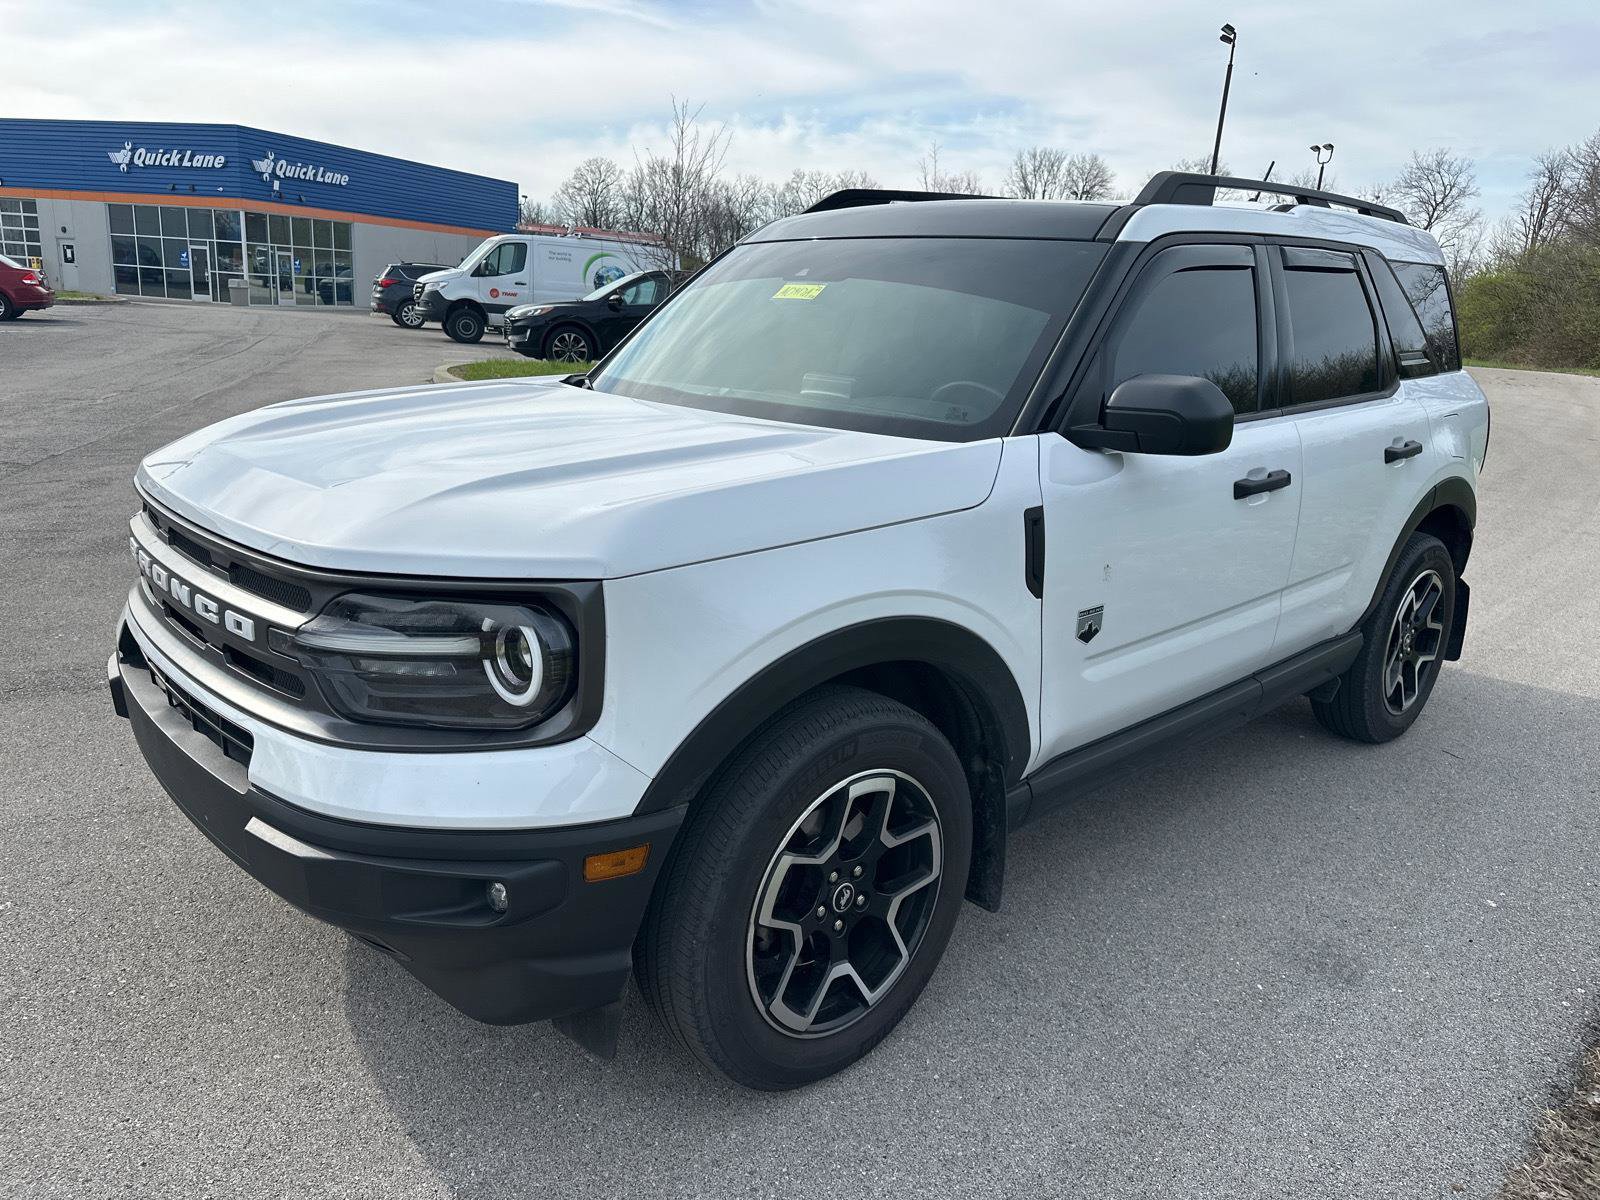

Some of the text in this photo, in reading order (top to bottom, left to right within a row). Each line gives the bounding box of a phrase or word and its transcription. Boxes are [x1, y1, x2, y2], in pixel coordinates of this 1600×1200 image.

[133, 147, 225, 169] Quick Lane
[275, 159, 349, 186] Quick Lane
